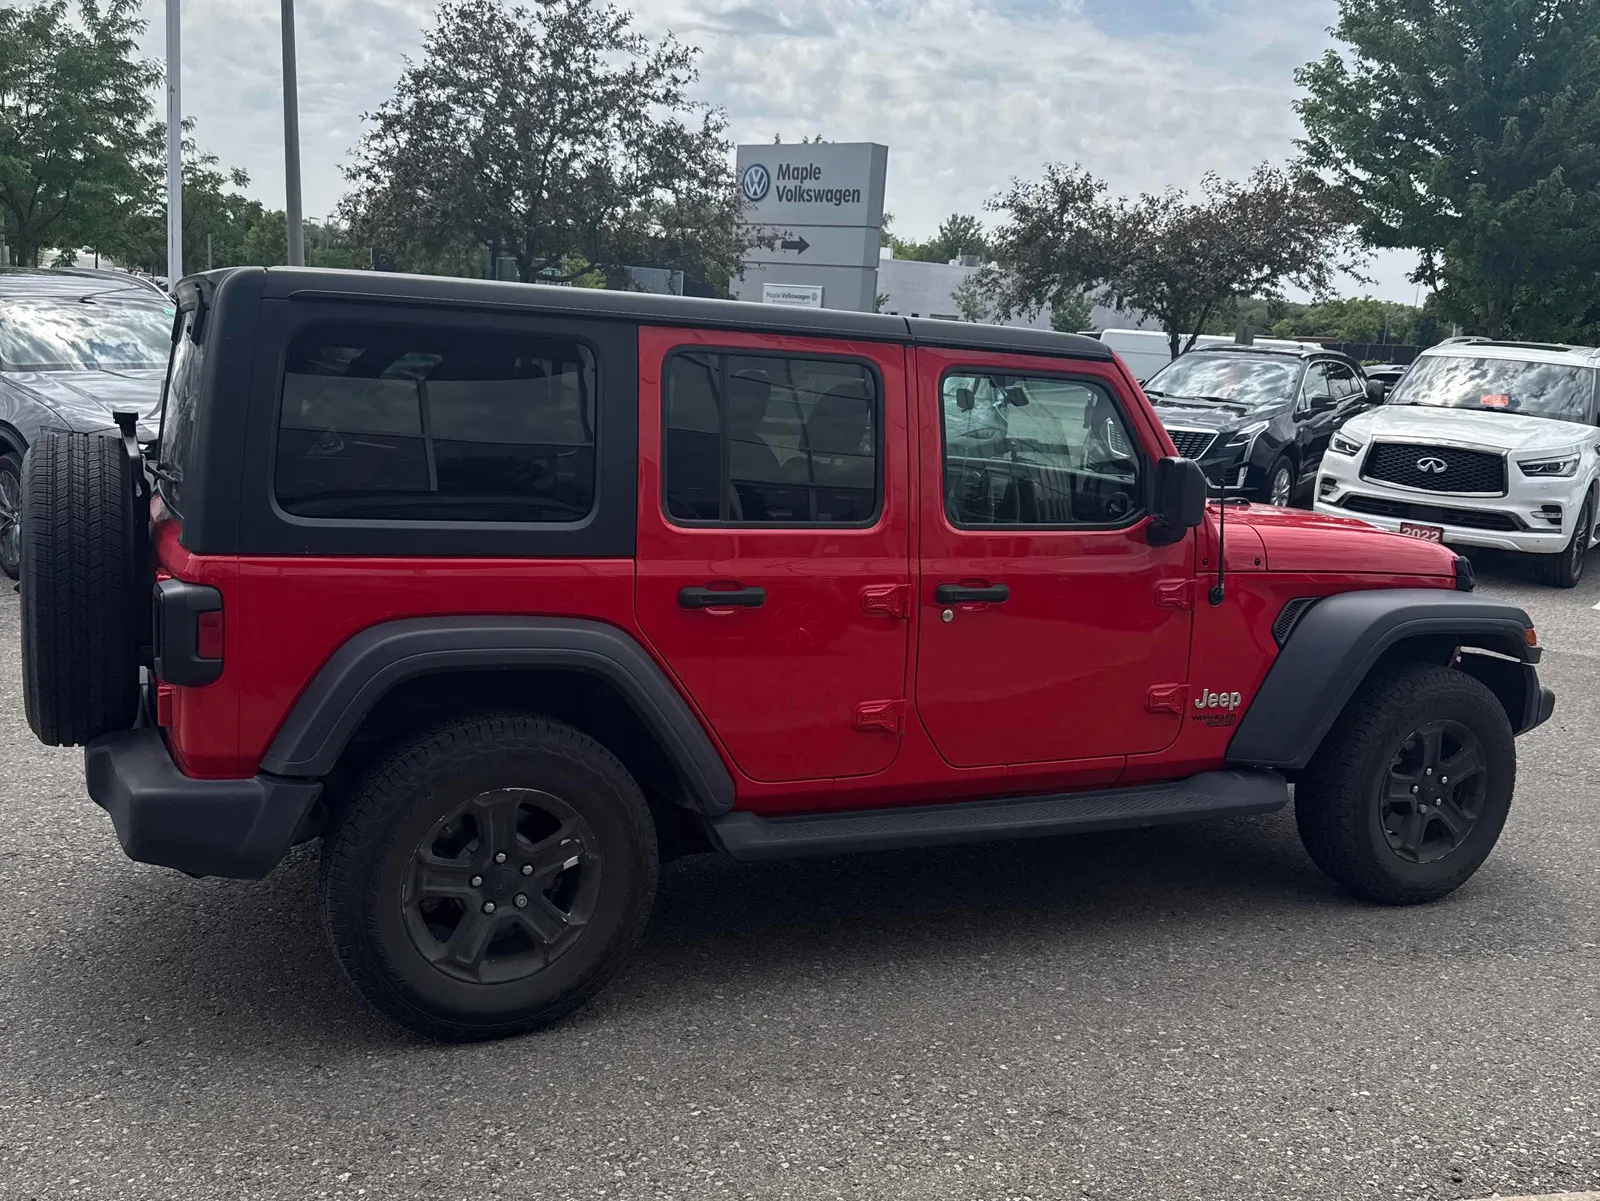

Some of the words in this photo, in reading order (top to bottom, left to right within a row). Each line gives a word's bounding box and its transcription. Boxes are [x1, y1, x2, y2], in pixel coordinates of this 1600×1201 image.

[777, 163, 822, 184] Maple
[776, 185, 860, 206] Volkswagen
[781, 292, 811, 301] Volkswagen
[1402, 527, 1440, 543] 2022
[1195, 689, 1241, 711] Jeep
